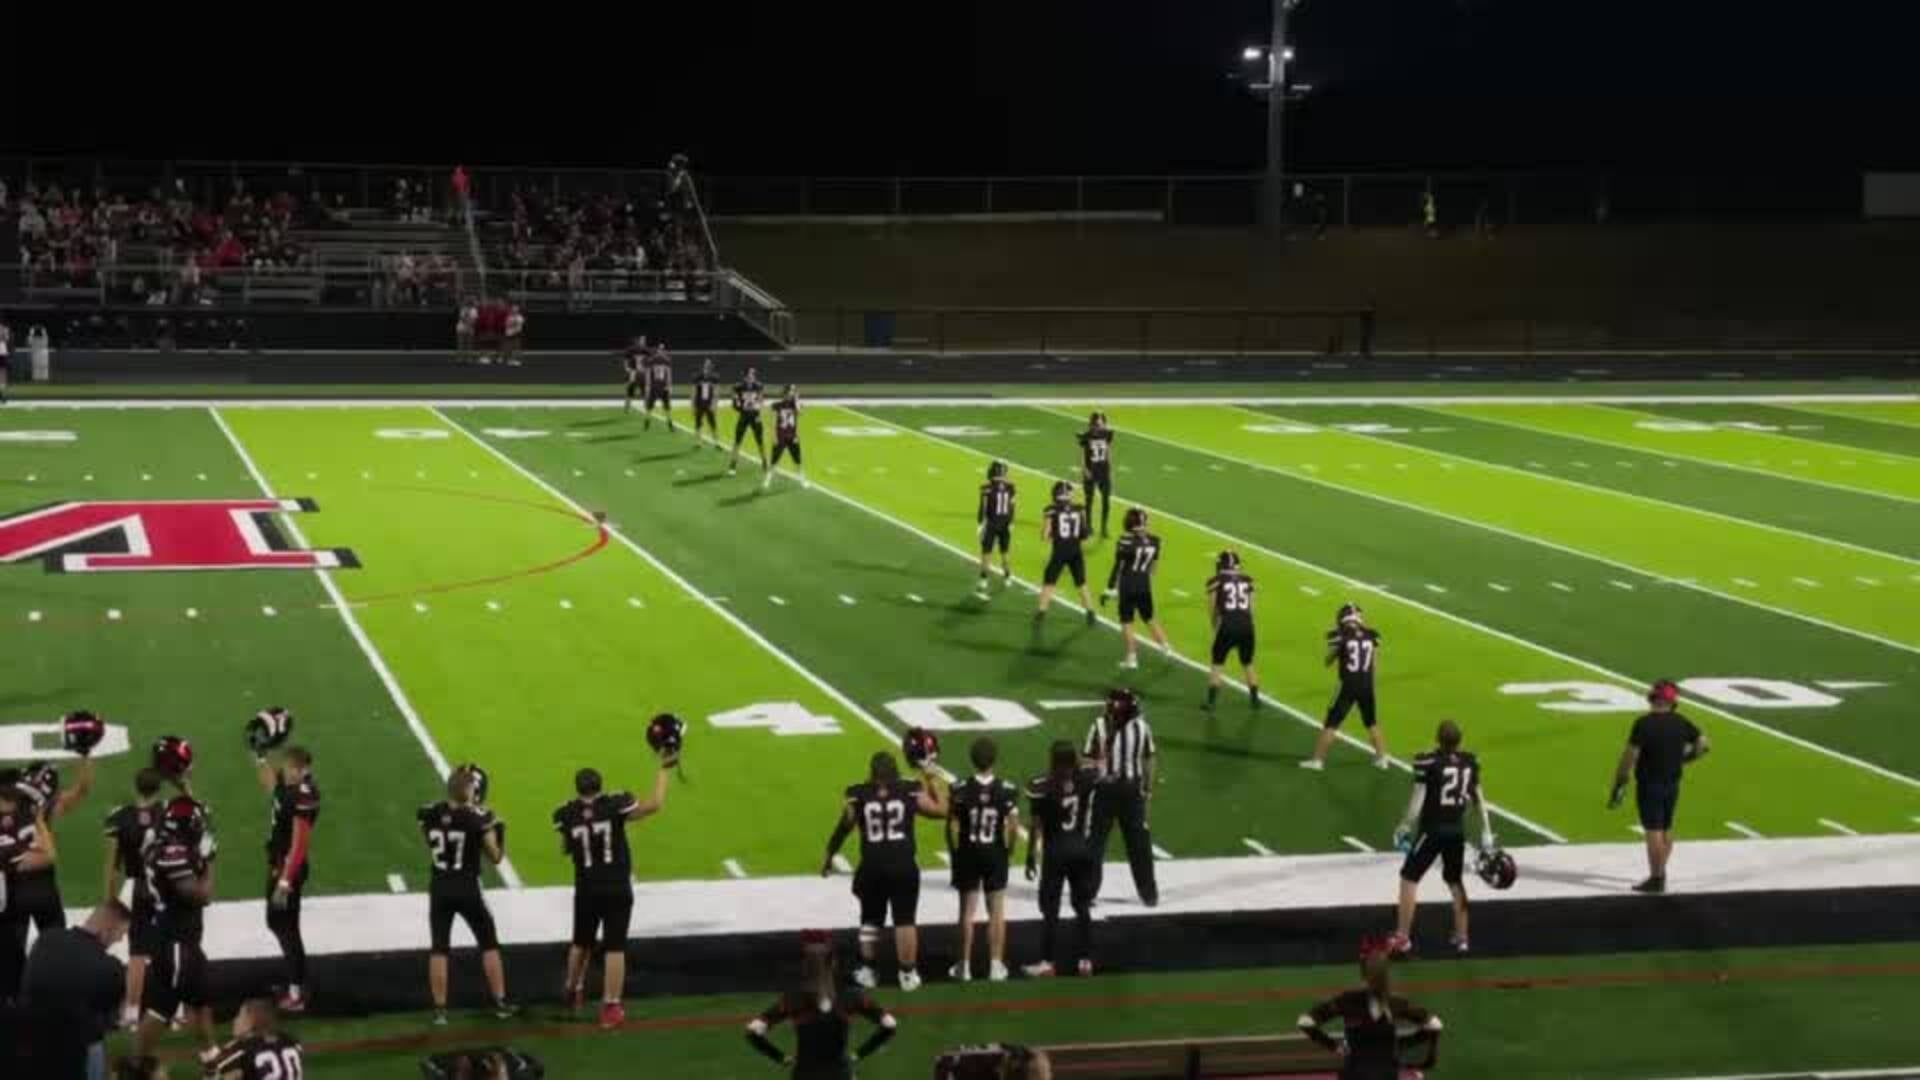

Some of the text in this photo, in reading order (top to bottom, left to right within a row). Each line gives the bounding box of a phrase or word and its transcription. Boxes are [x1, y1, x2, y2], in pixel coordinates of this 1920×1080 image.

[995, 491, 1010, 515] 11
[1059, 511, 1080, 538] 67
[1132, 546, 1156, 571] 17
[1224, 582, 1249, 609] 35
[1346, 640, 1373, 672] 37
[1497, 677, 1844, 712] 30
[707, 696, 1042, 736] 40
[1440, 766, 1472, 806] 21
[864, 800, 904, 842] 62
[969, 806, 998, 843] 10
[429, 829, 466, 869] 27
[572, 822, 612, 867] 77
